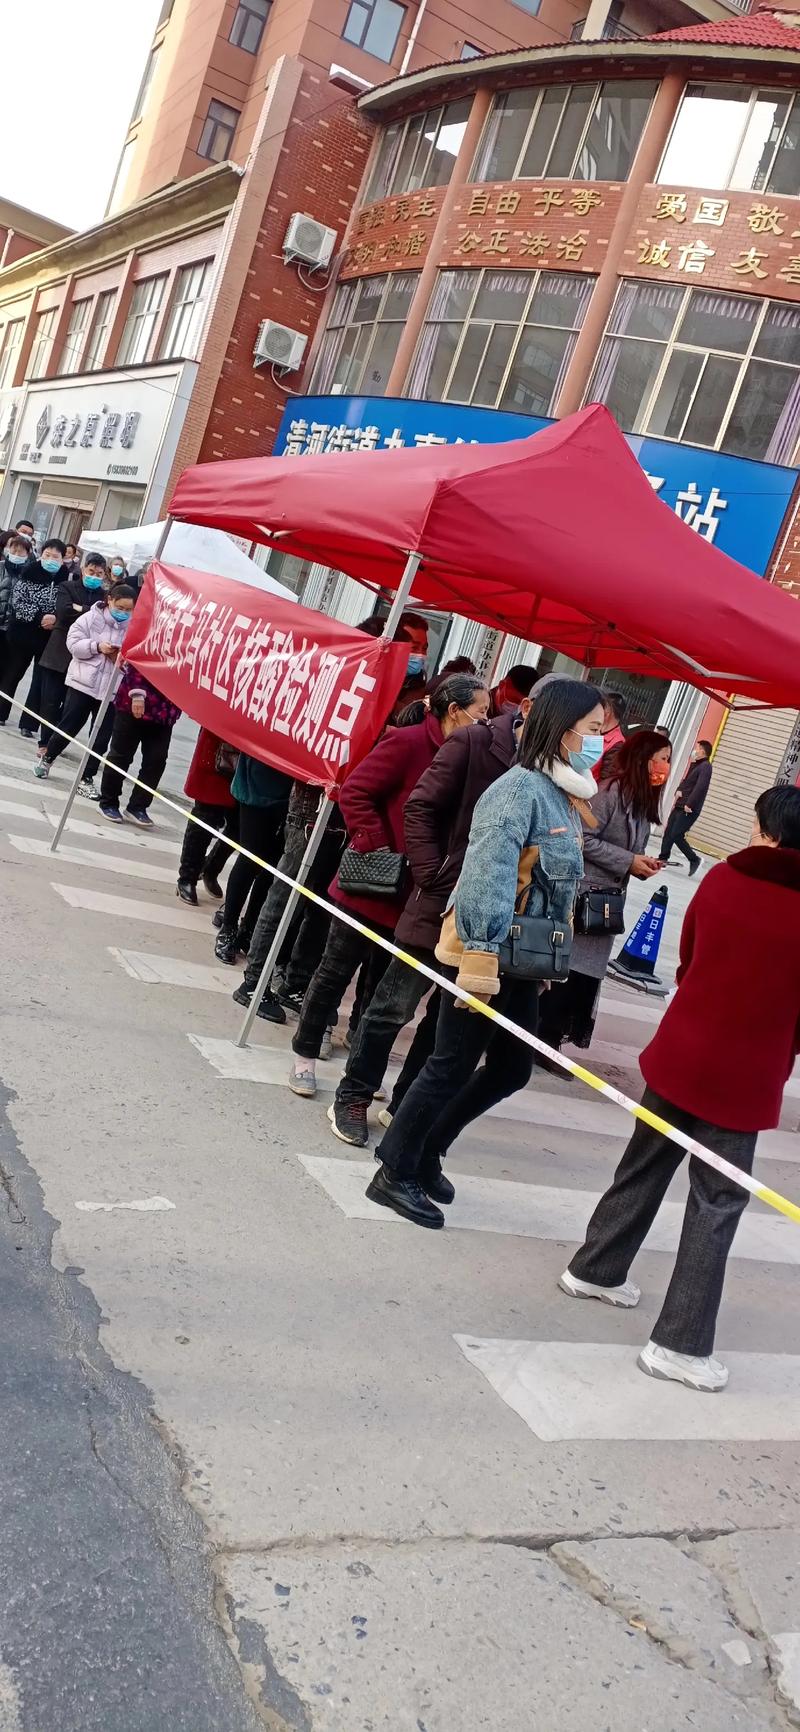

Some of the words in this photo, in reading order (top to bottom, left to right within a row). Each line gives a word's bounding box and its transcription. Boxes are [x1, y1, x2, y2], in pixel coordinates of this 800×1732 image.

[467, 191, 521, 216] 自由
[534, 188, 602, 216] 平等
[655, 193, 730, 227] 爱国
[747, 202, 800, 239] 敬
[457, 229, 510, 254] 公正
[519, 231, 588, 261] 法治
[637, 238, 716, 274] 诚信
